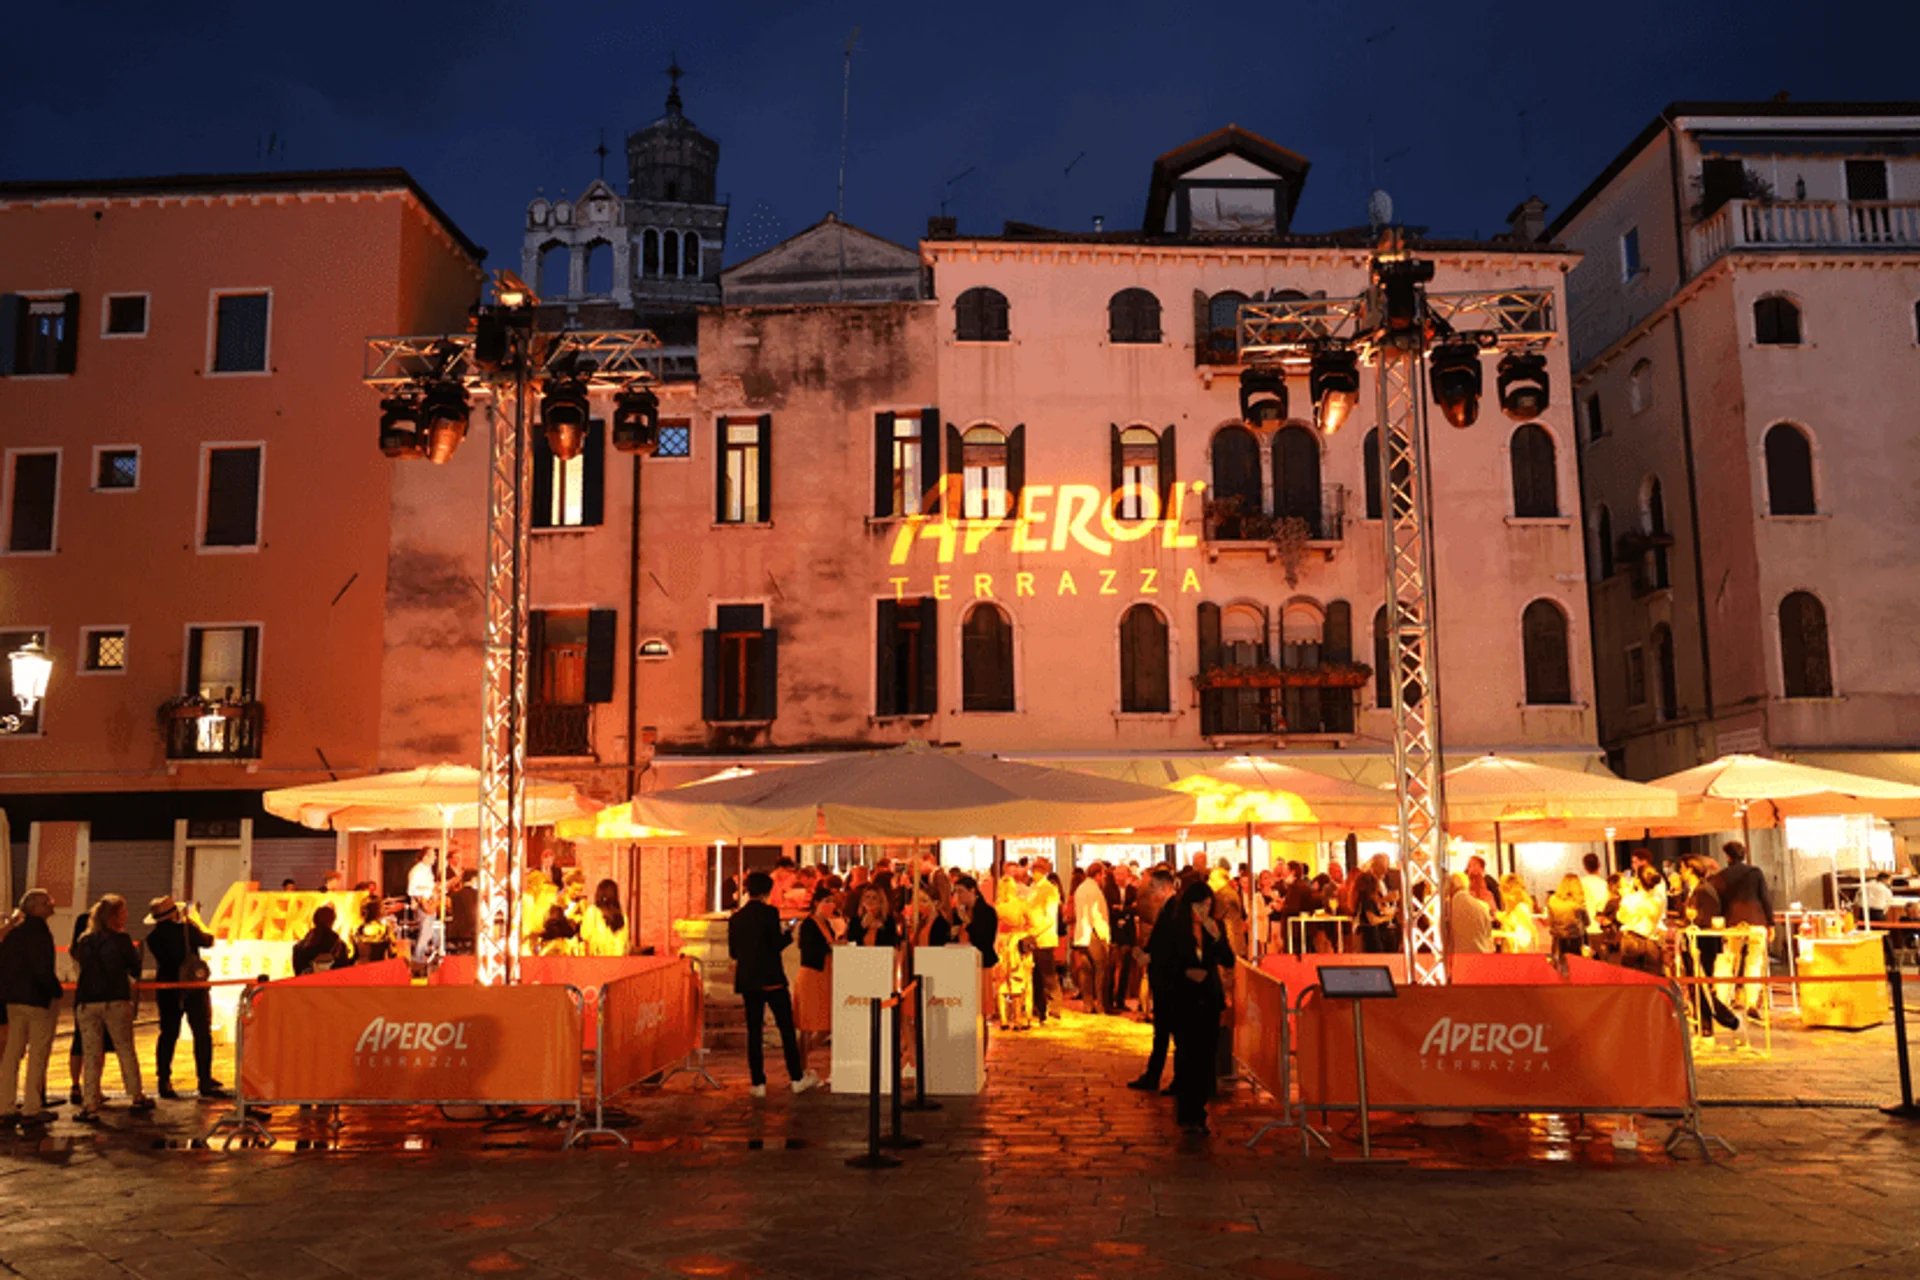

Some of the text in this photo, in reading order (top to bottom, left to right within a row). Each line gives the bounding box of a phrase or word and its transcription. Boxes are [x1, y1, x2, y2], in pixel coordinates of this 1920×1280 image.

[889, 568, 1202, 601] TERRAZZA
[355, 1016, 468, 1052] APEROL
[1419, 1017, 1549, 1055] APEROL
